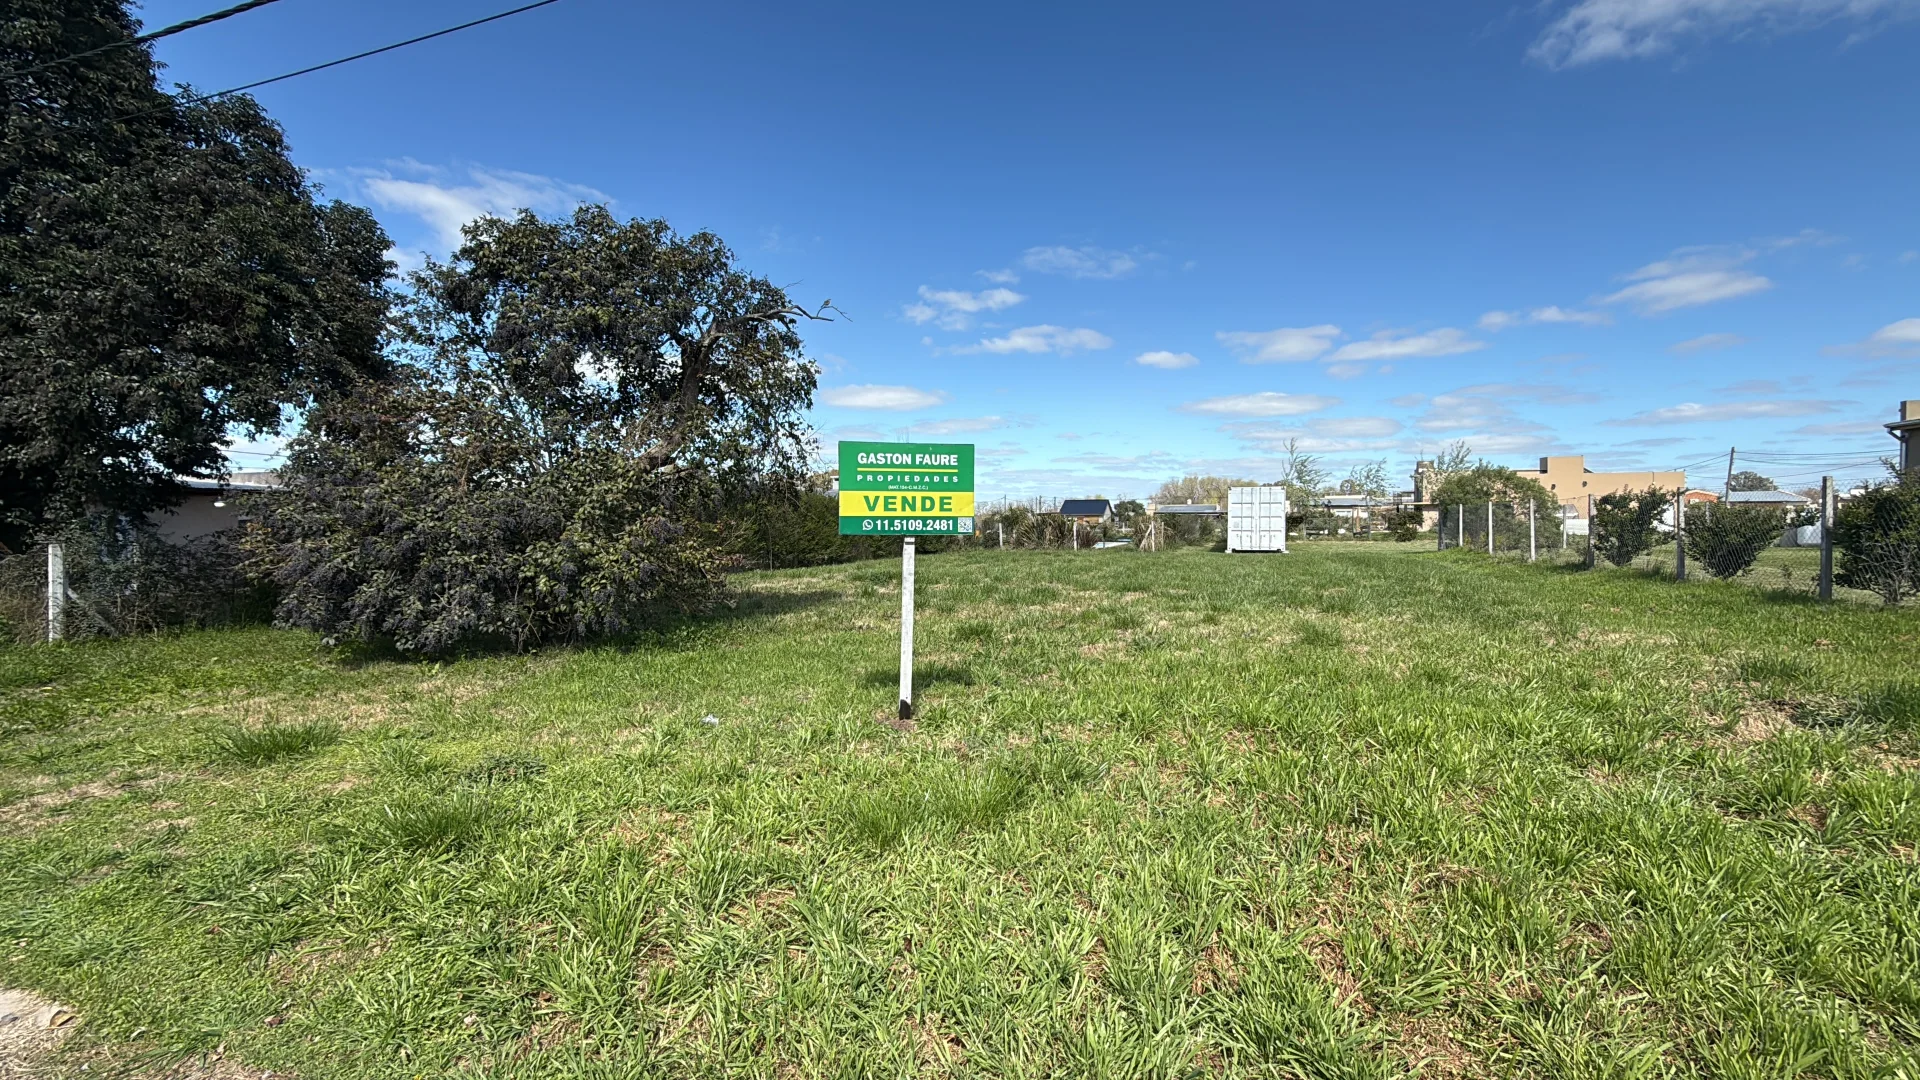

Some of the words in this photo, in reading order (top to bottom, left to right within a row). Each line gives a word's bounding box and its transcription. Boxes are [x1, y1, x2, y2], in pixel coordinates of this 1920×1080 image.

[857, 452, 912, 466] GASTON
[915, 453, 959, 466] FAURE
[857, 474, 959, 483] PROPIEDADES
[863, 495, 953, 512] VENDE
[875, 519, 953, 531] 11.5109.2481
